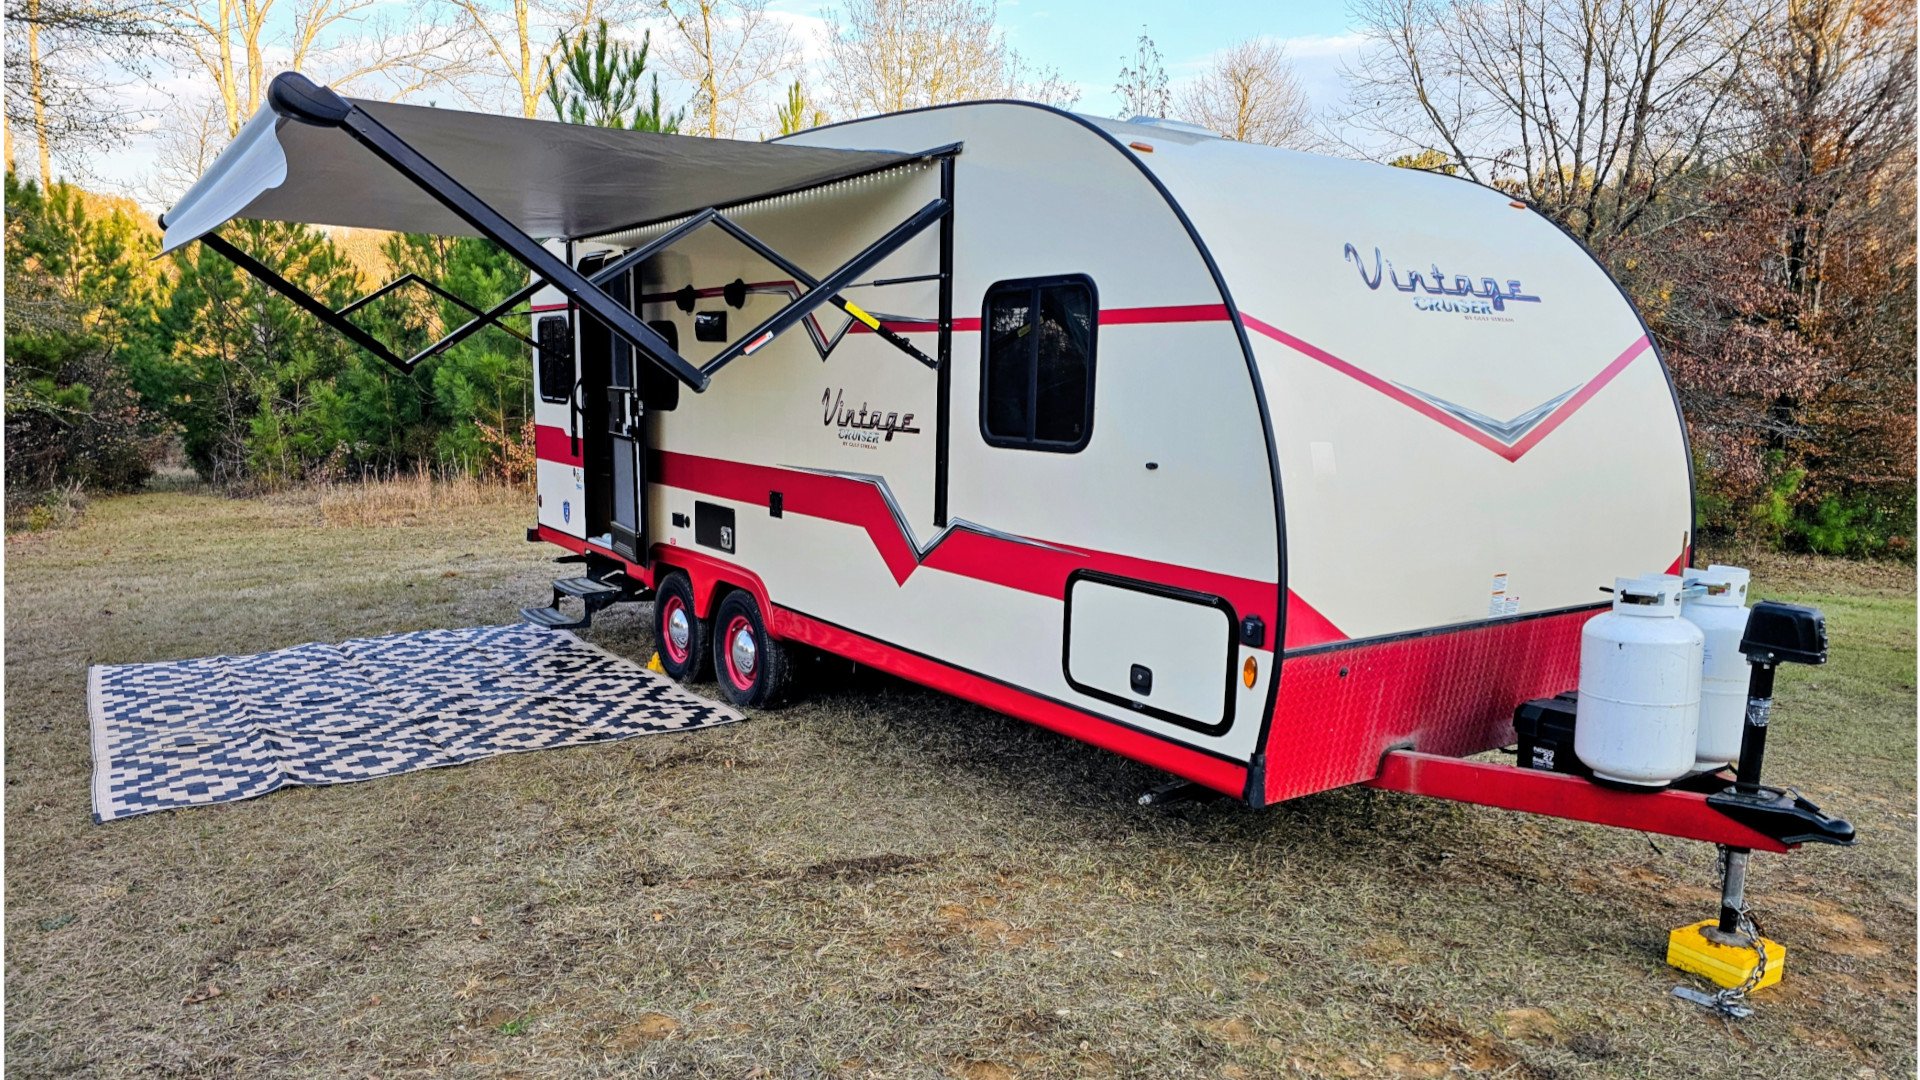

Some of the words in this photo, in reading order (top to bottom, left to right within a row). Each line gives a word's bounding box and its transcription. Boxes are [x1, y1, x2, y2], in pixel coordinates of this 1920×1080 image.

[1344, 243, 1541, 311] Vintage
[1413, 296, 1493, 314] CRUISER
[822, 387, 920, 442] Vintage
[838, 428, 880, 444] CRUISER
